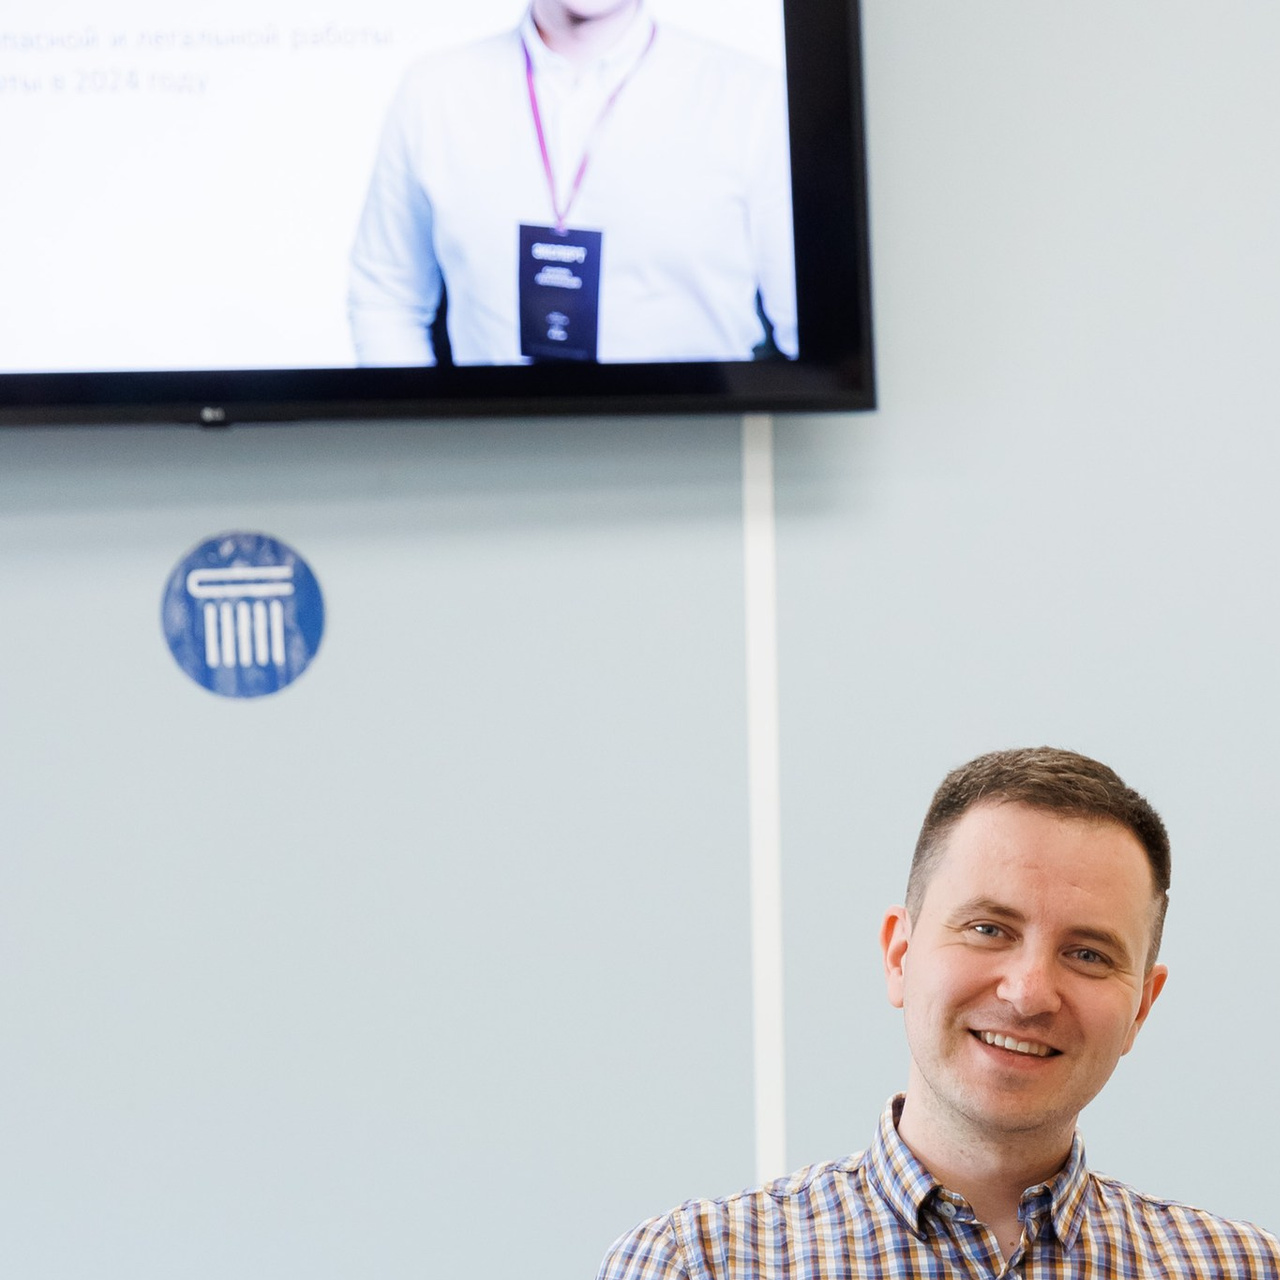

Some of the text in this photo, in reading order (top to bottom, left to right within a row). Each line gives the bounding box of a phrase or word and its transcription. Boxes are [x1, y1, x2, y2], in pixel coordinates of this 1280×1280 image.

[290, 21, 393, 53] работы
[75, 68, 139, 93] 2024
[146, 69, 209, 97] году
